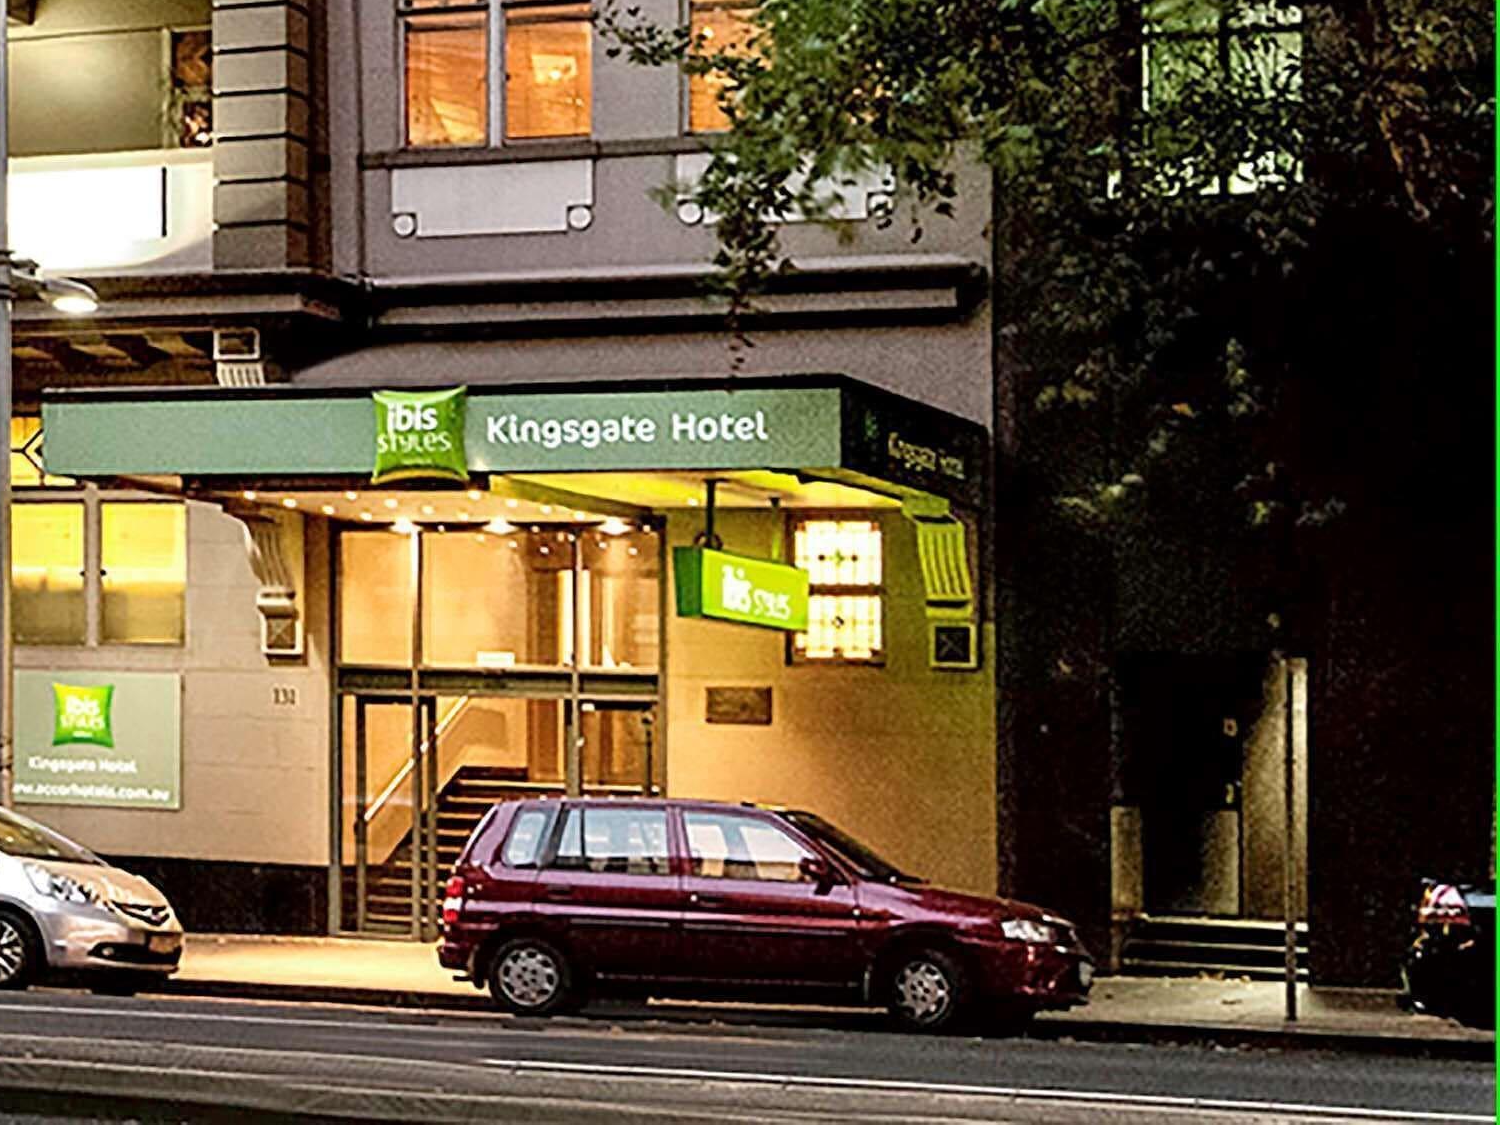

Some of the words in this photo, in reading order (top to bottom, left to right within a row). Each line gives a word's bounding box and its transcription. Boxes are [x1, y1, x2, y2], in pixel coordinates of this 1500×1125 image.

[387, 402, 438, 431] ibis
[486, 415, 655, 448] Kingsgate
[672, 411, 768, 441] Hotel
